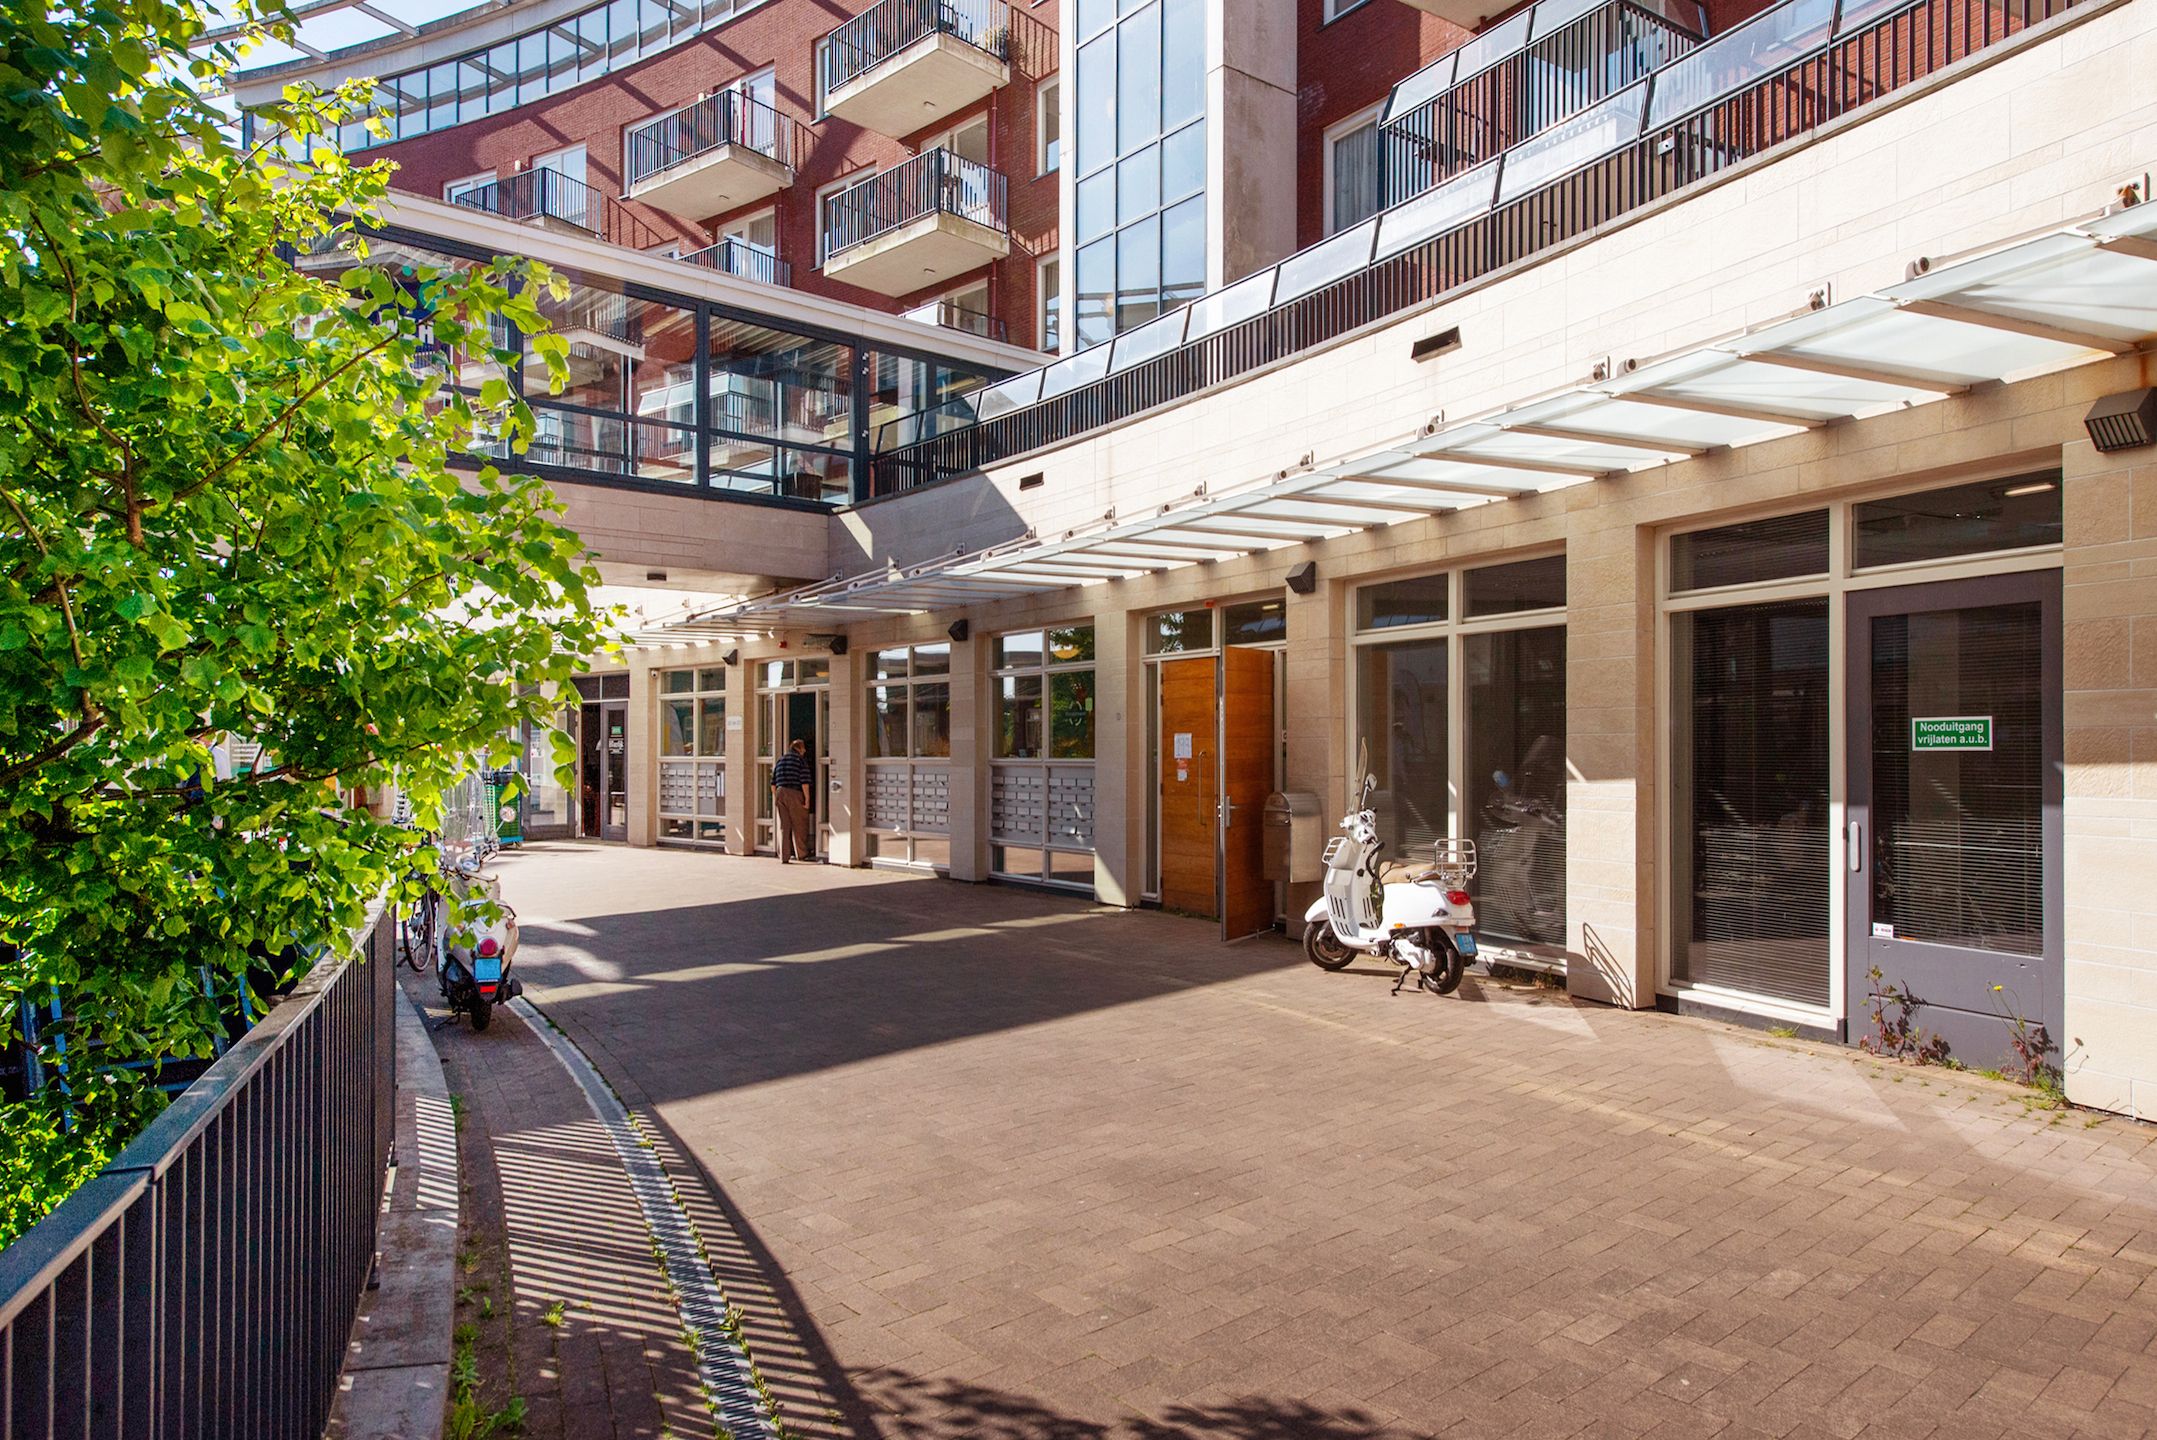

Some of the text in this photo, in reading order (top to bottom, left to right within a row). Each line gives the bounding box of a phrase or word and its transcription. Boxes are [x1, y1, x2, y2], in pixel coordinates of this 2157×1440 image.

[1920, 722, 1984, 733] Nooduitgang
[1918, 734, 1987, 746] vrijlaten a.u.b.
